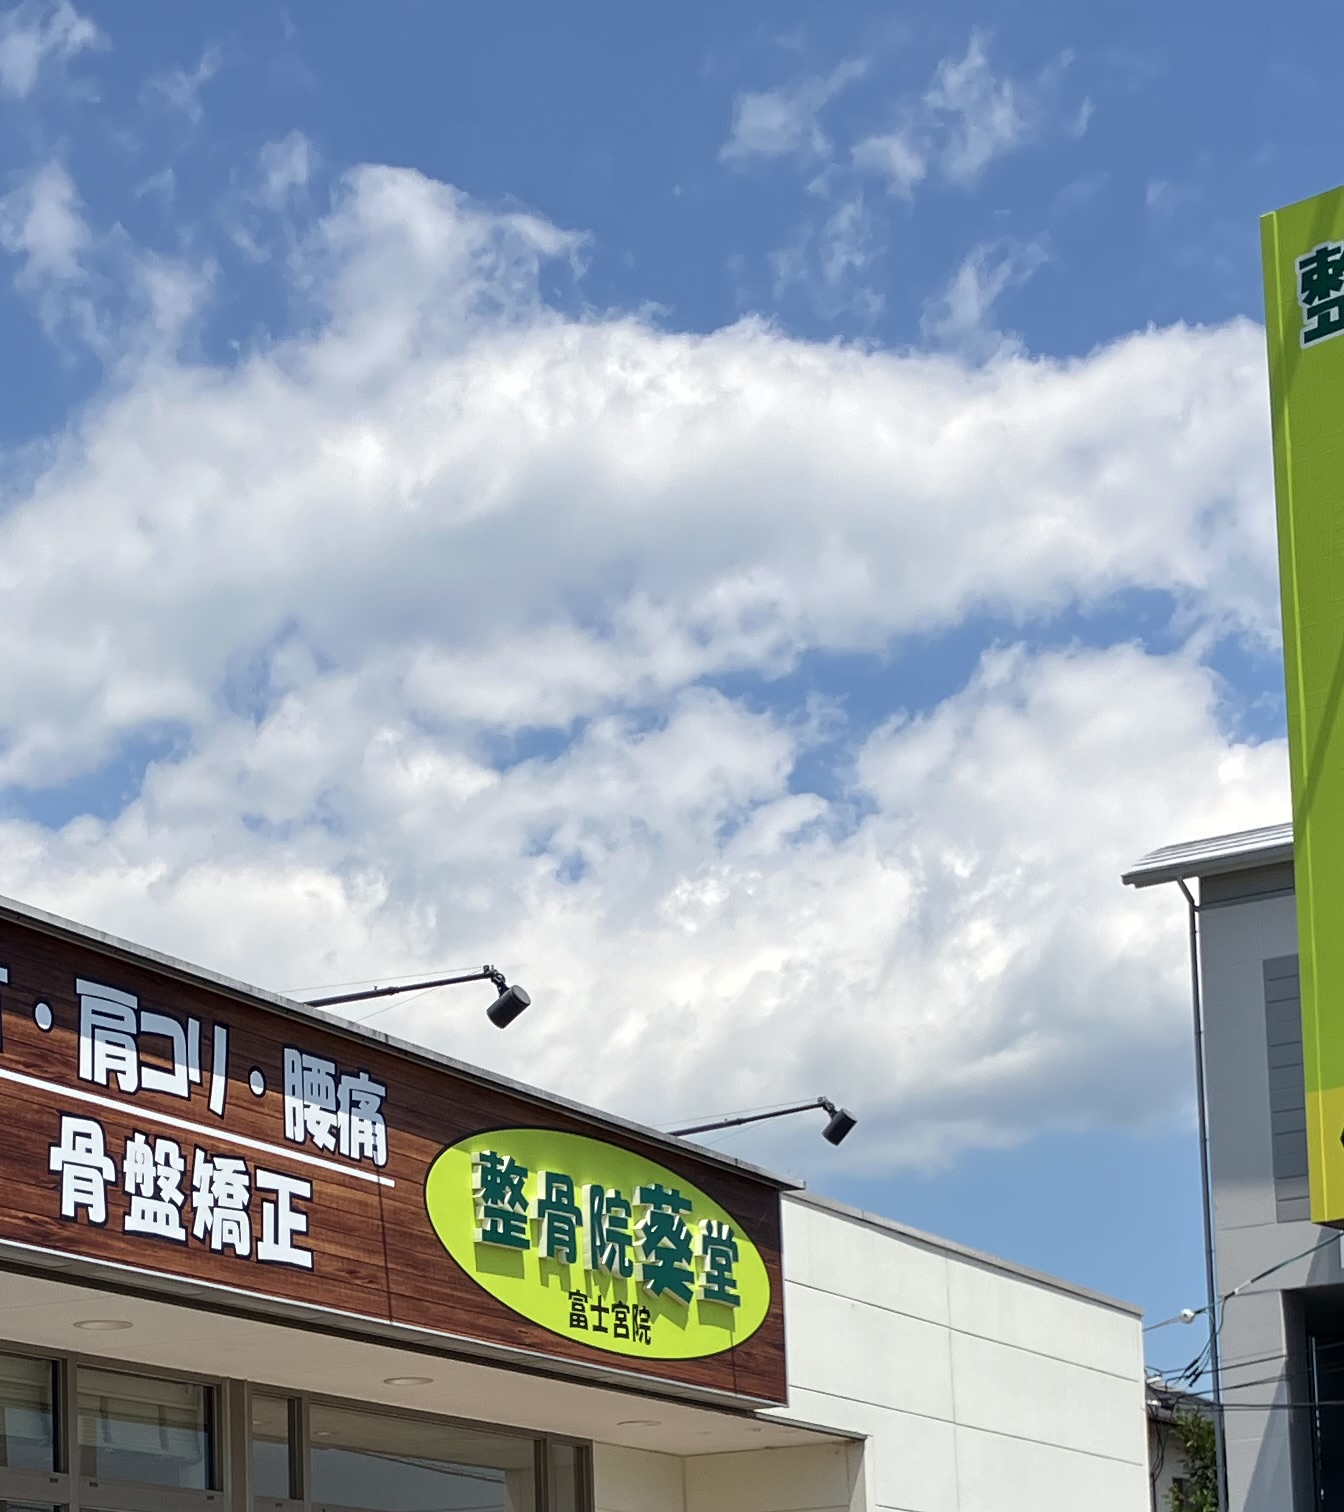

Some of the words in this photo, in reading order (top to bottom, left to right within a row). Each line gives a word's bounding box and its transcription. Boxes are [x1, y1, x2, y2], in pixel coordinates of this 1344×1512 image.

[50, 1113, 313, 1270] 骨盤矯正
[471, 1149, 741, 1309] 整骨院葵堂
[567, 1290, 652, 1347] 富士宮院
